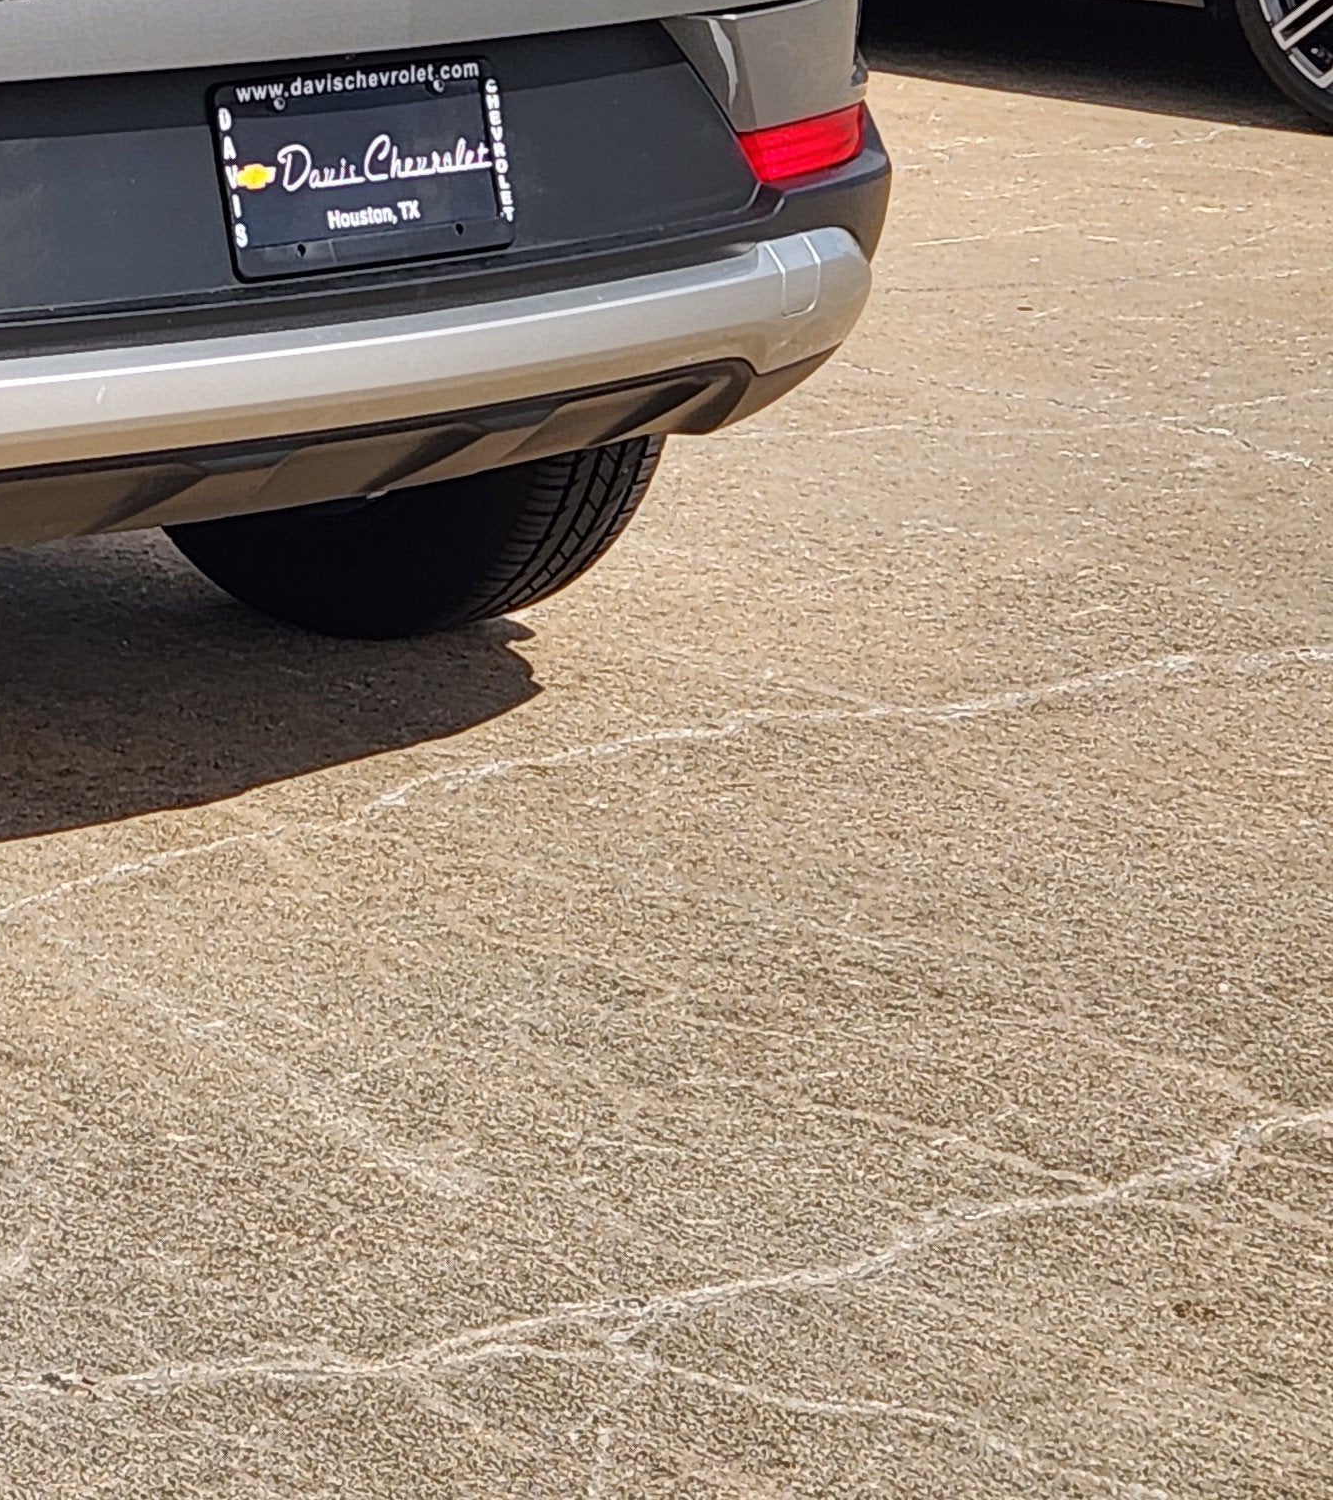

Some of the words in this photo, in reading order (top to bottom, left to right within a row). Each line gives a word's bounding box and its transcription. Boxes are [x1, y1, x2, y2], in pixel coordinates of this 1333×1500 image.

[235, 61, 480, 104] www.davischevrolet.com
[218, 107, 248, 248] DAVIS
[277, 143, 366, 192] Davis
[363, 133, 493, 182] Chevrolet
[485, 78, 515, 222] CHEVROLET
[326, 206, 398, 230] Houston,
[397, 200, 421, 221] TX
